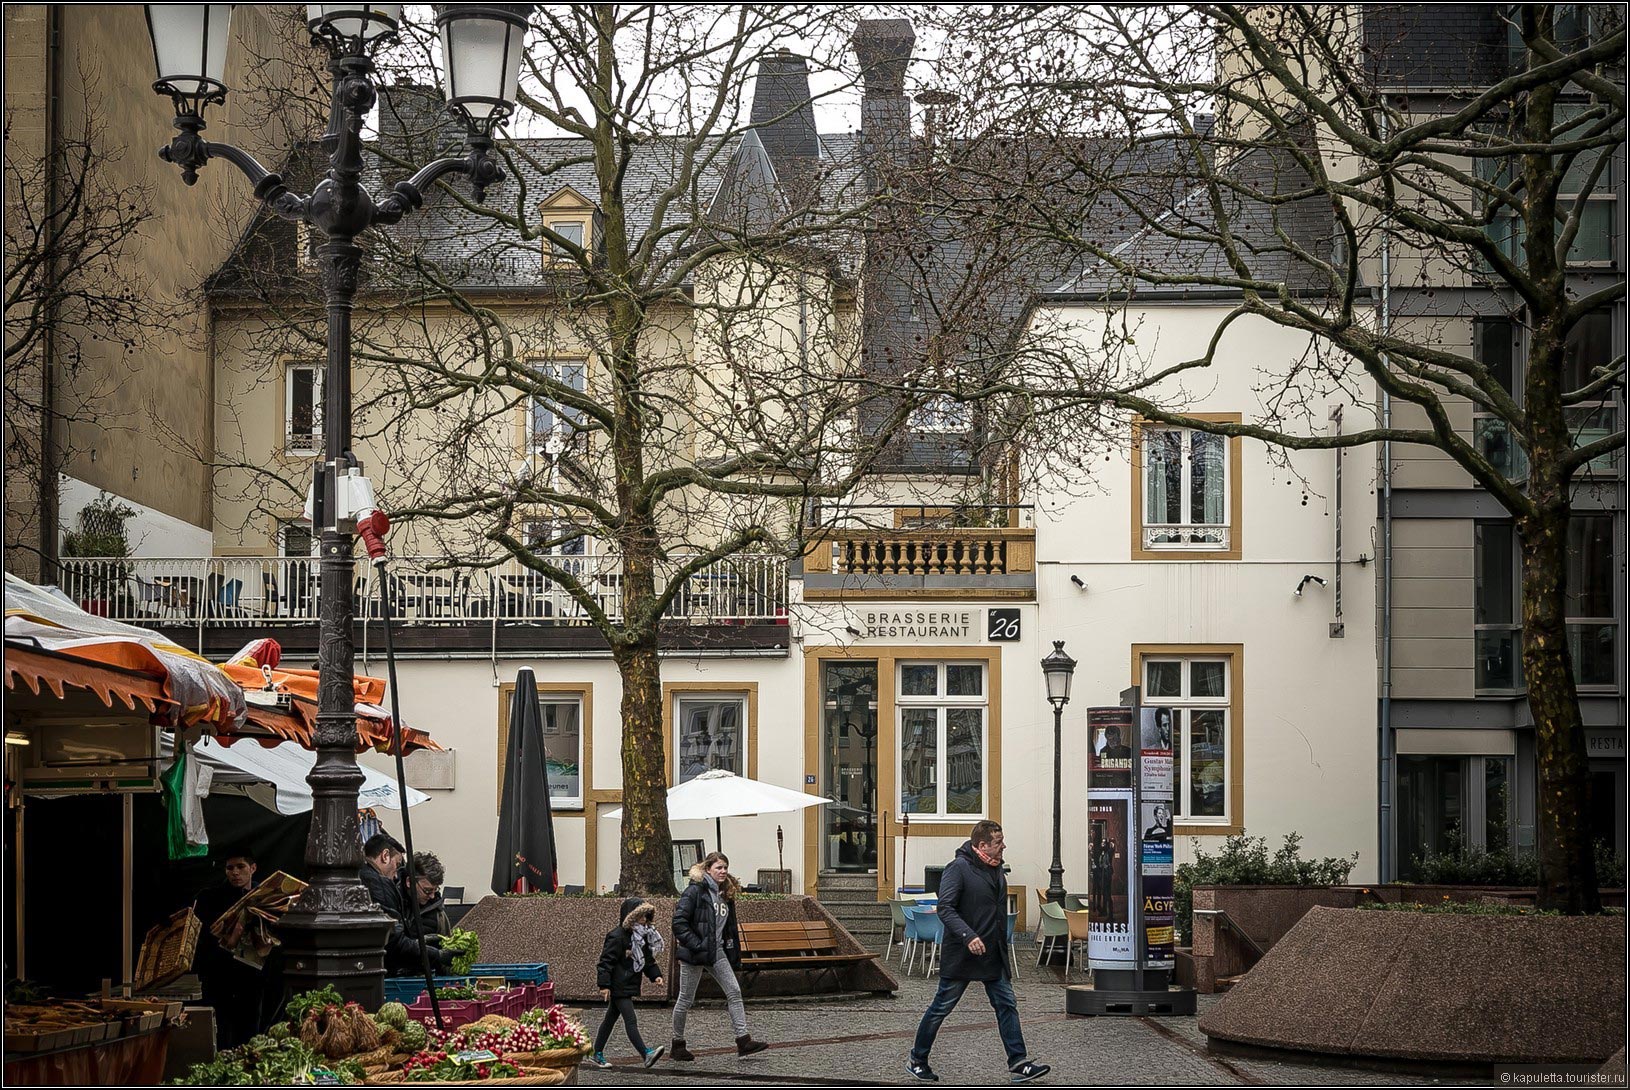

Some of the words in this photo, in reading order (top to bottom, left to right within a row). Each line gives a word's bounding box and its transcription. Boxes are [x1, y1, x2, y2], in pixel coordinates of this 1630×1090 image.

[867, 612, 970, 624] BRASSERIE
[867, 626, 970, 637] RESTAURANT
[990, 618, 1019, 638] 26
[1101, 758, 1132, 768] BRIGANDS
[1023, 1066, 1031, 1074] N
